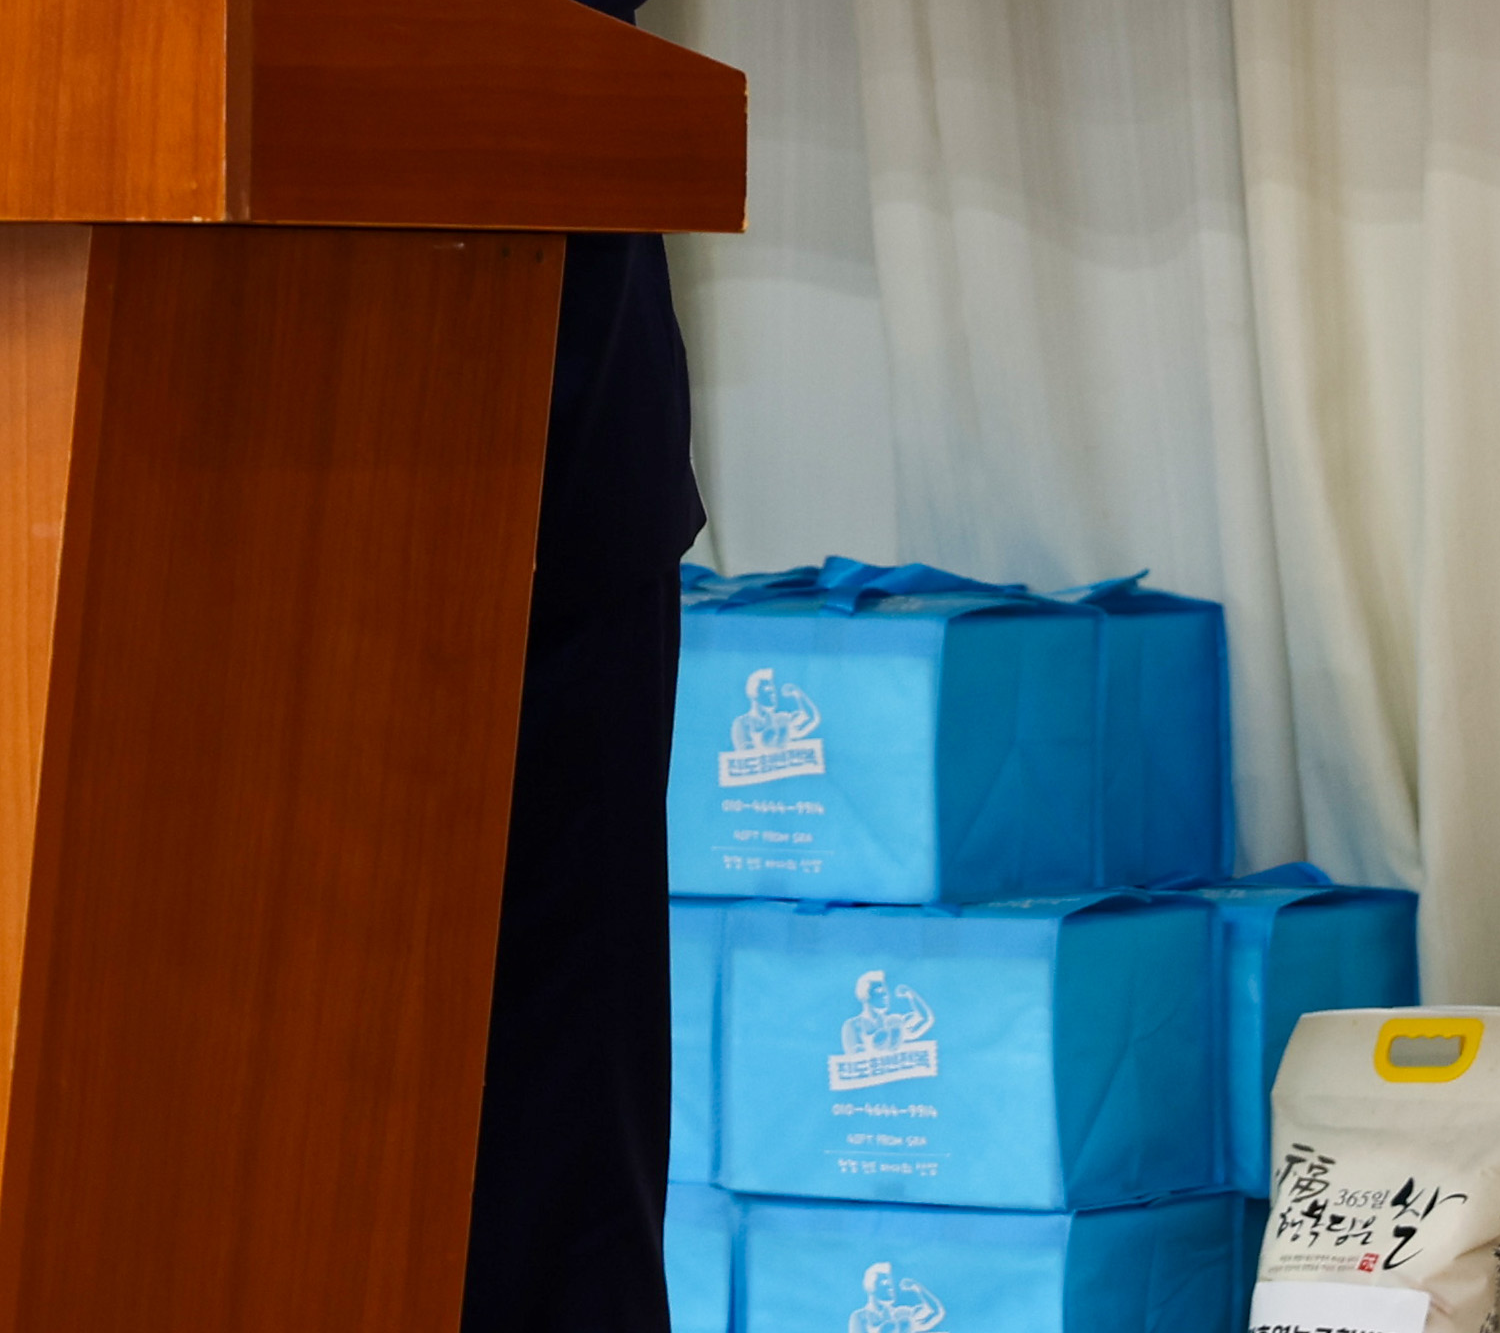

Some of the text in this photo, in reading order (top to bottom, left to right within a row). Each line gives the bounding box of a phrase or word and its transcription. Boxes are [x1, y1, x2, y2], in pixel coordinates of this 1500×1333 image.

[1276, 1198, 1376, 1247] 행복담은
[1334, 1189, 1390, 1210] 365일
[1382, 1177, 1469, 1270] 쌀
